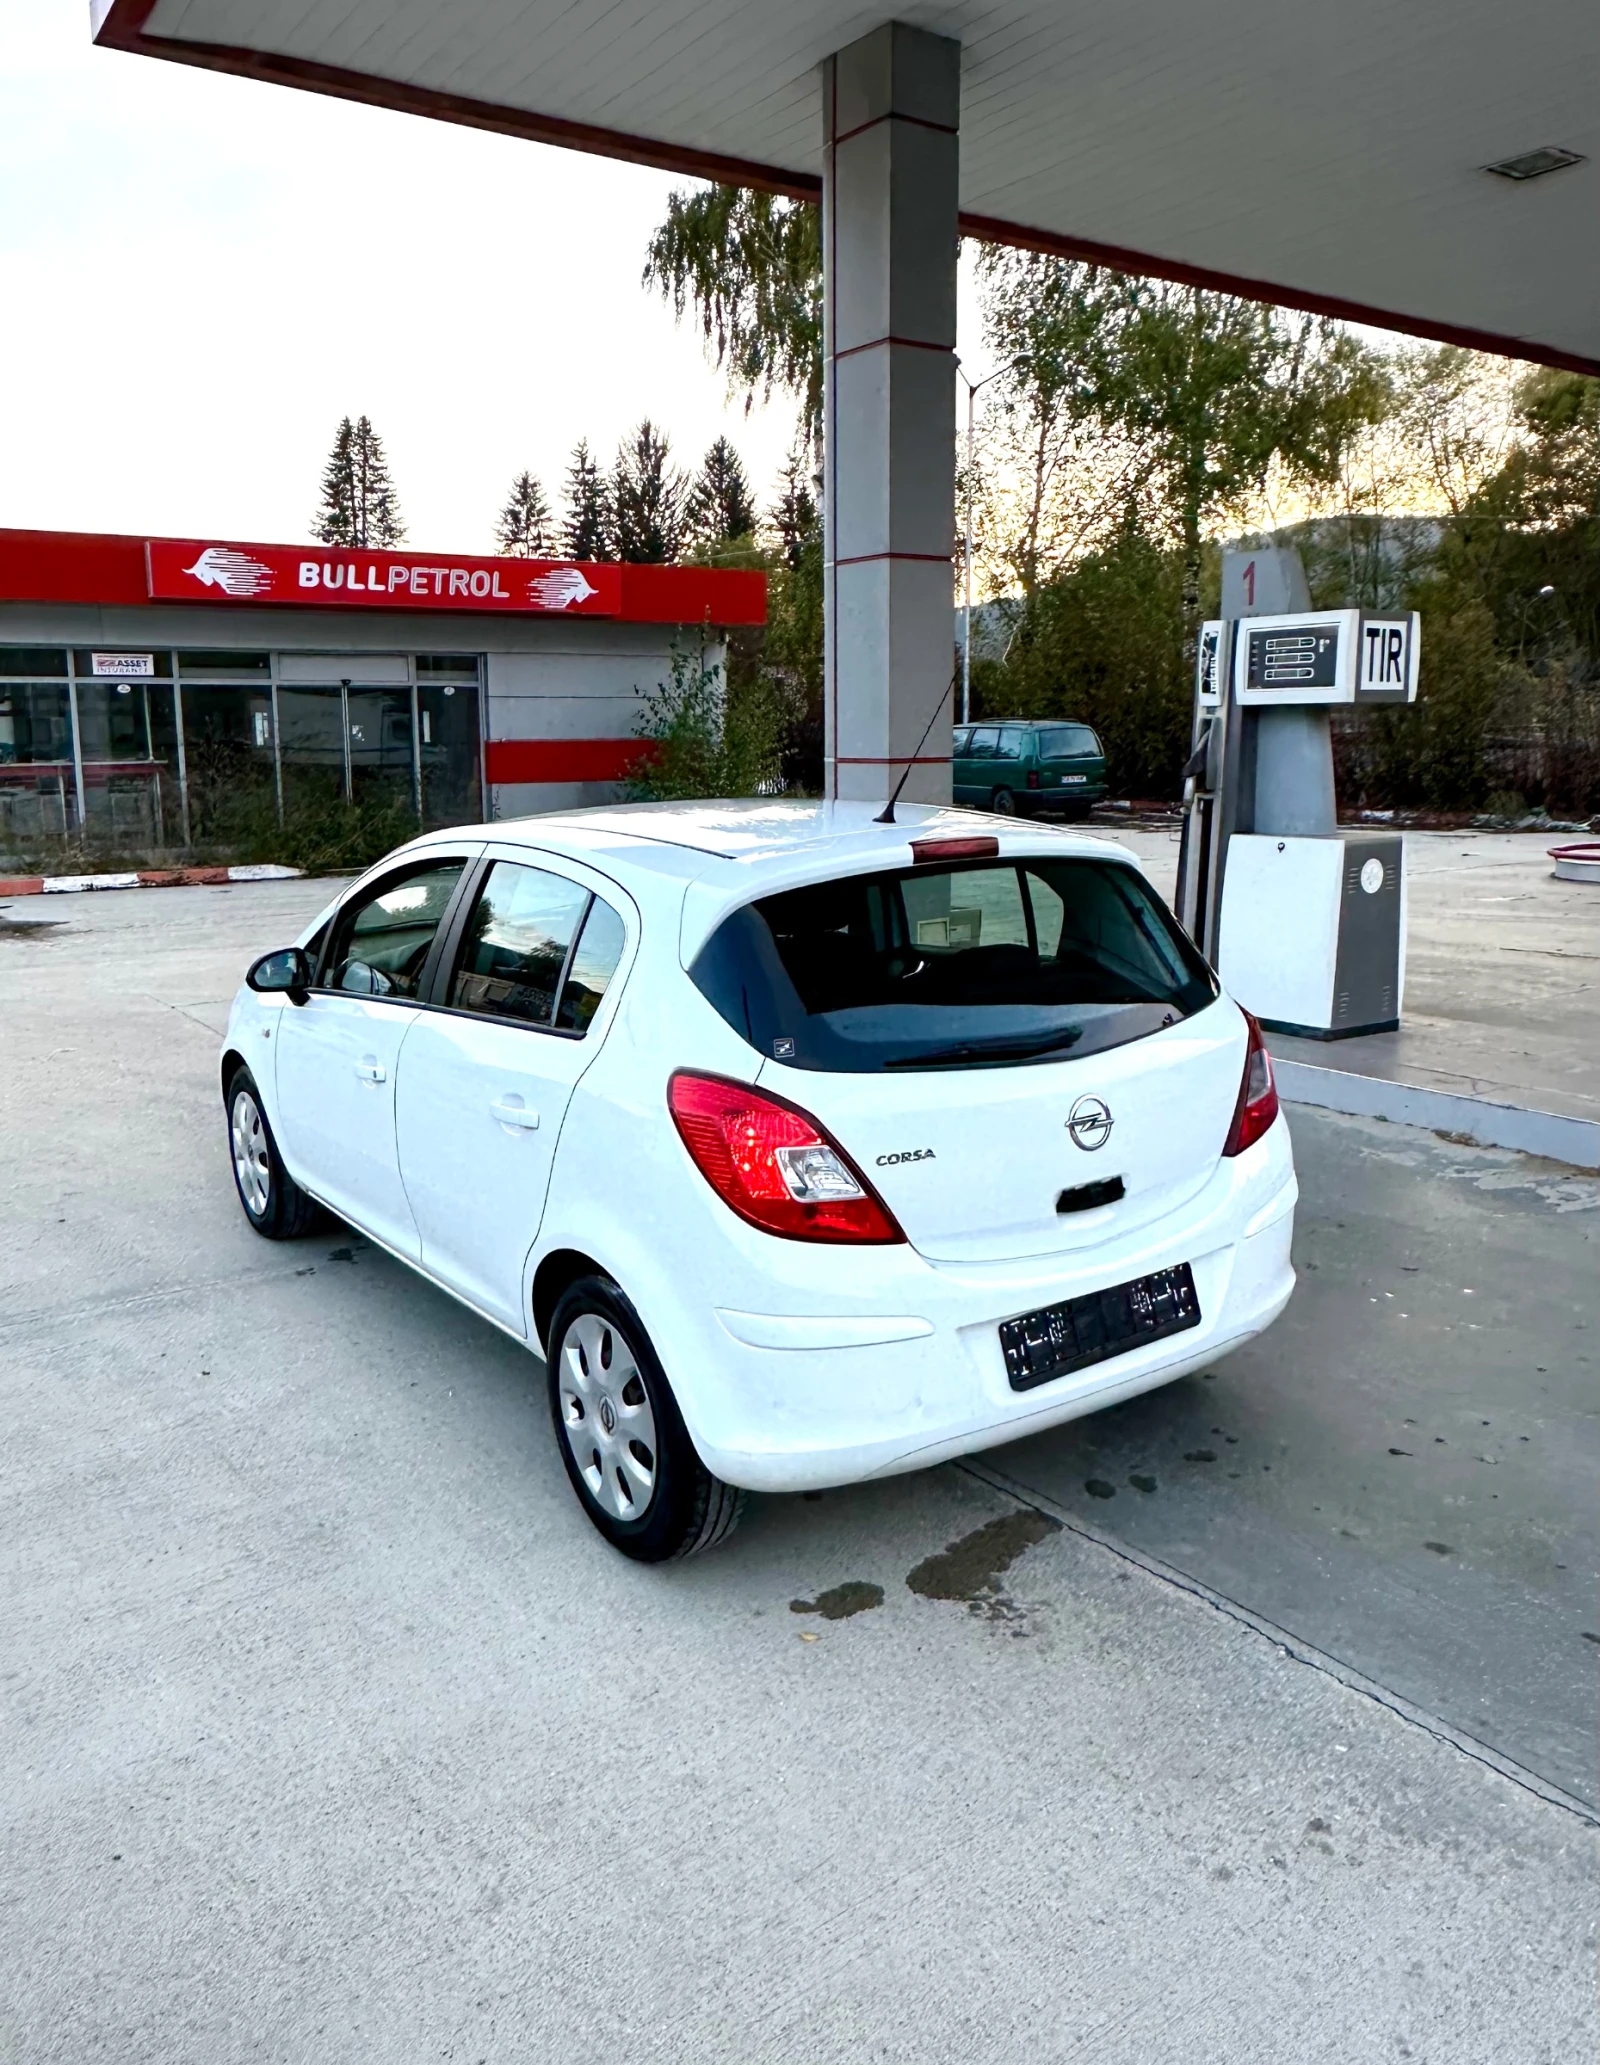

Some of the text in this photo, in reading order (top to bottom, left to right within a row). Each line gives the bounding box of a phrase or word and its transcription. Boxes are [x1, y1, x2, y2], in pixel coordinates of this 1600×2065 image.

[1243, 560, 1255, 606] 1
[117, 659, 148, 667] ASSET
[1366, 627, 1402, 683] TIR
[875, 1148, 937, 1166] CORSA
